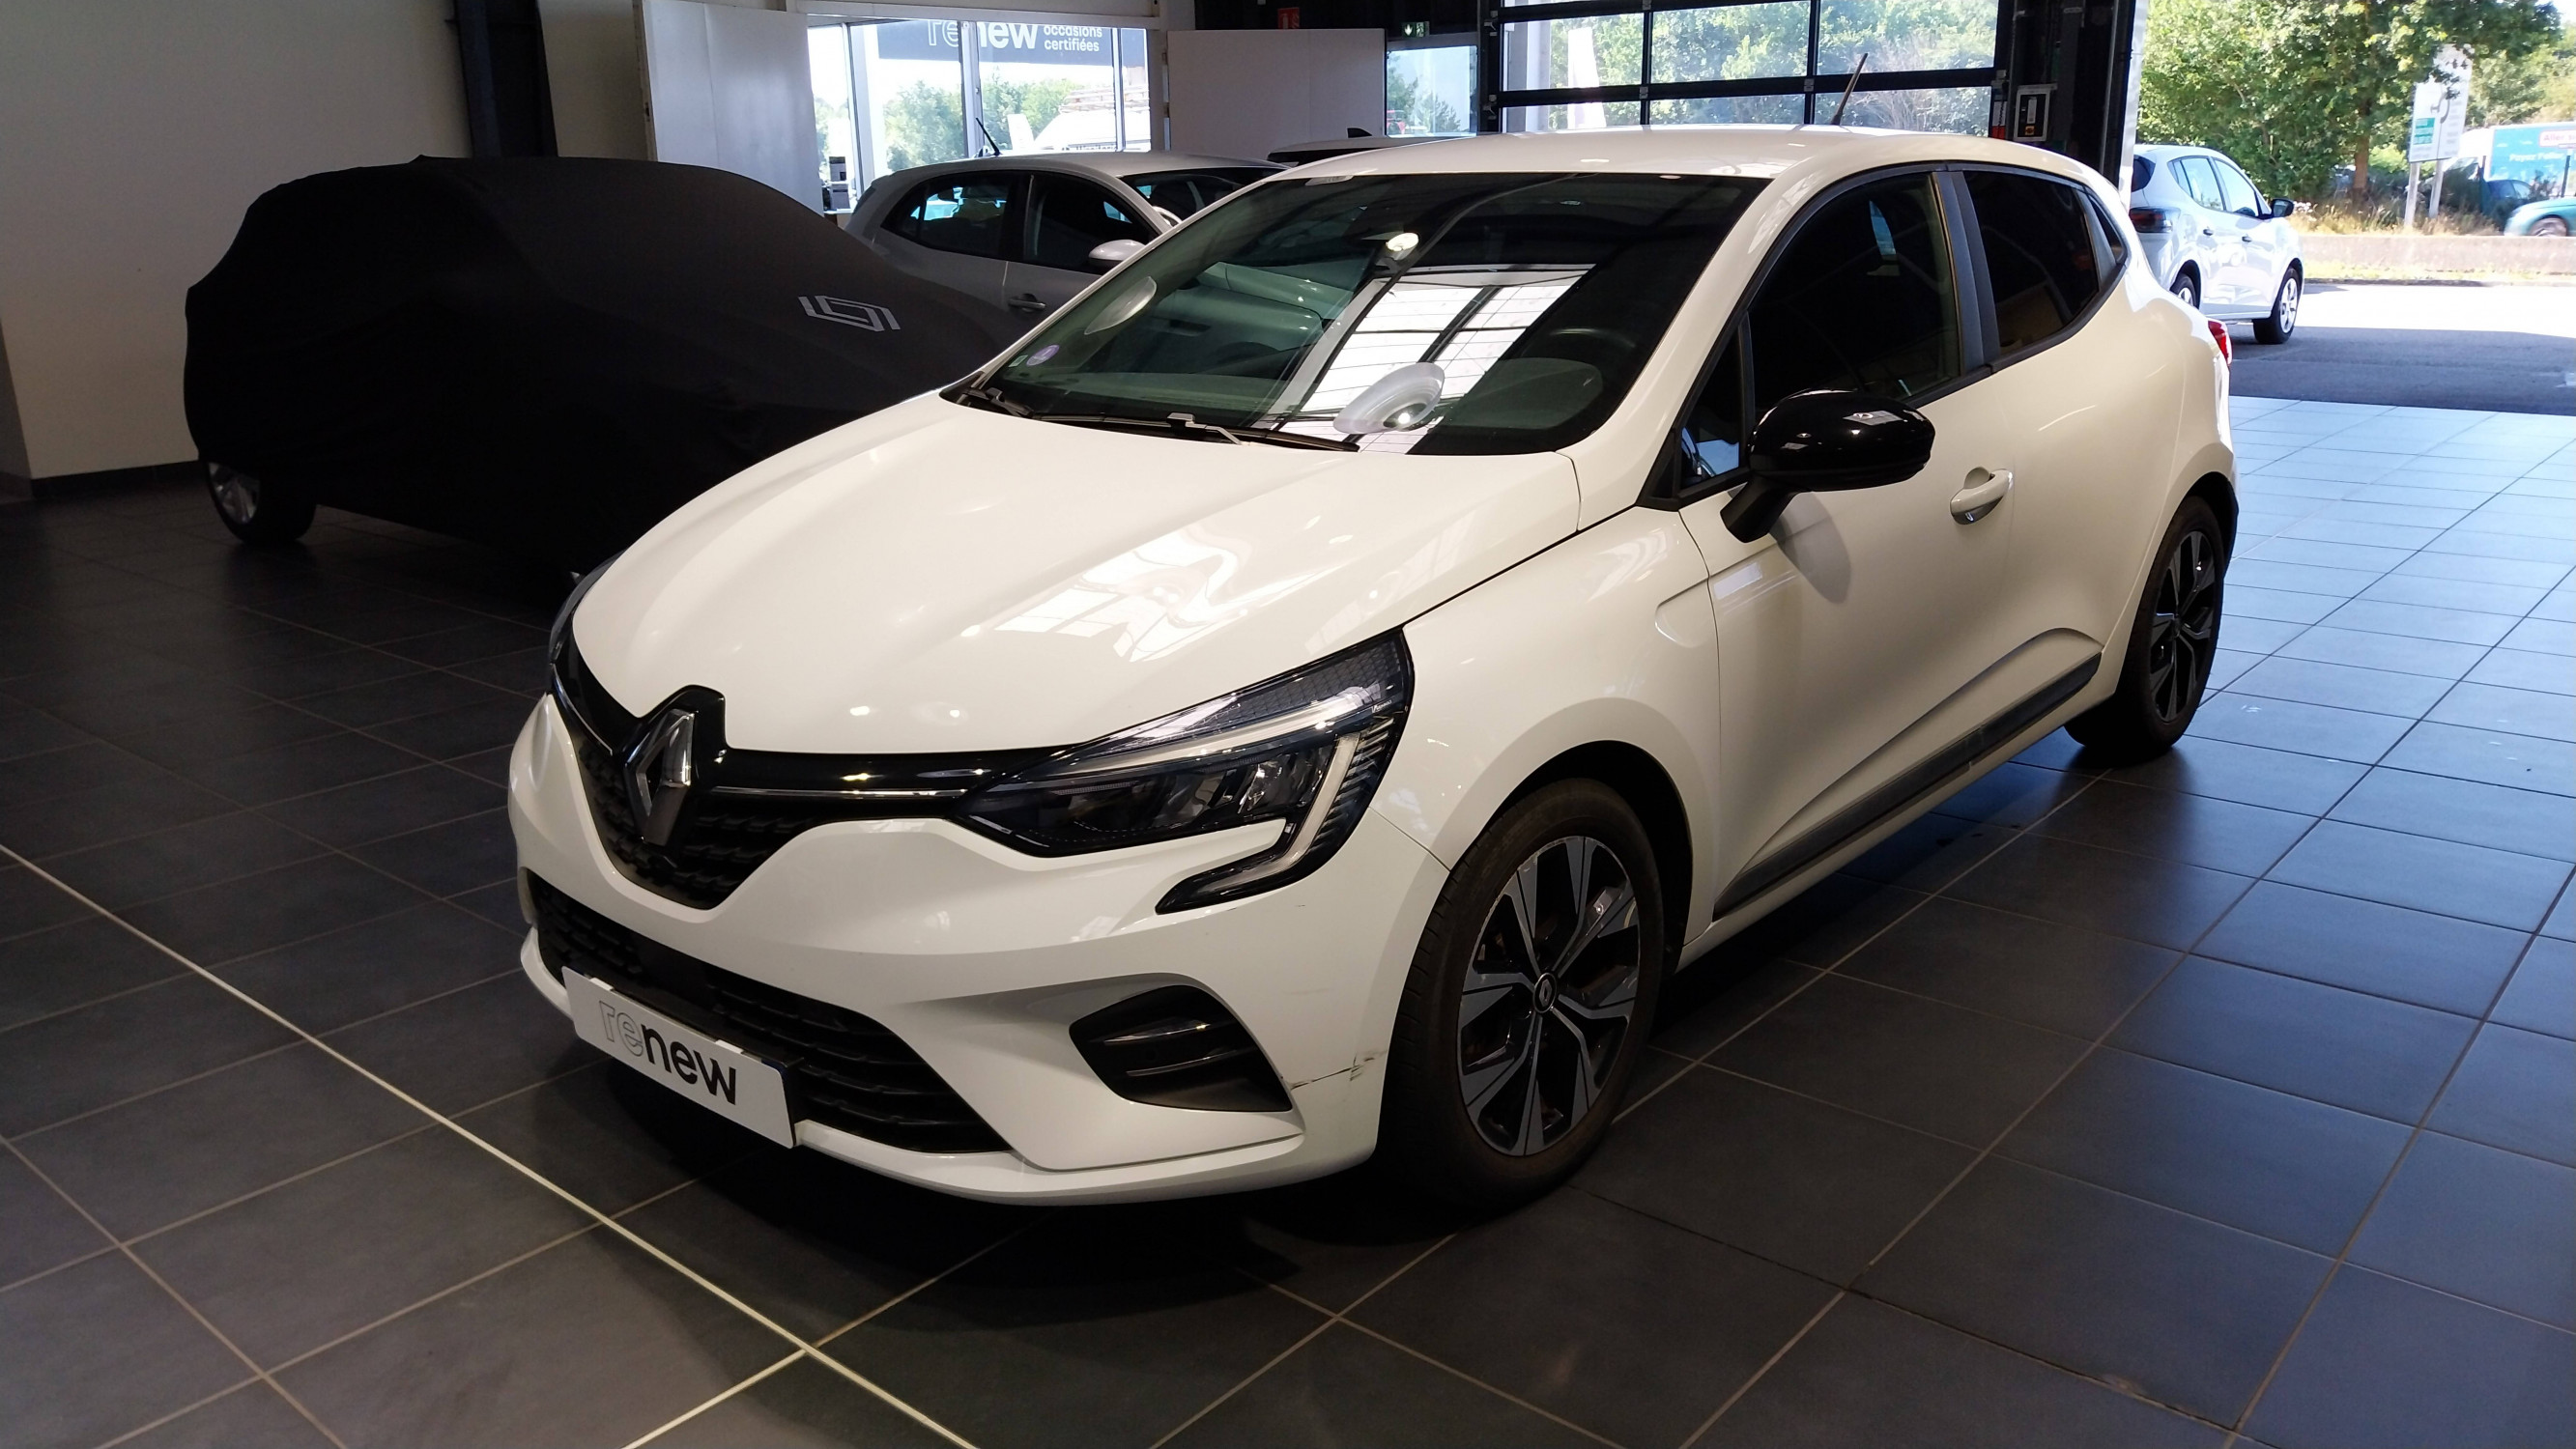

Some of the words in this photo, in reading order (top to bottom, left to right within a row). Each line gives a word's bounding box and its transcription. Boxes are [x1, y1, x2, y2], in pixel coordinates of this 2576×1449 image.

[1044, 25, 1102, 38] occasions
[1044, 38, 1100, 52] certifiées
[598, 1000, 736, 1106] renew
